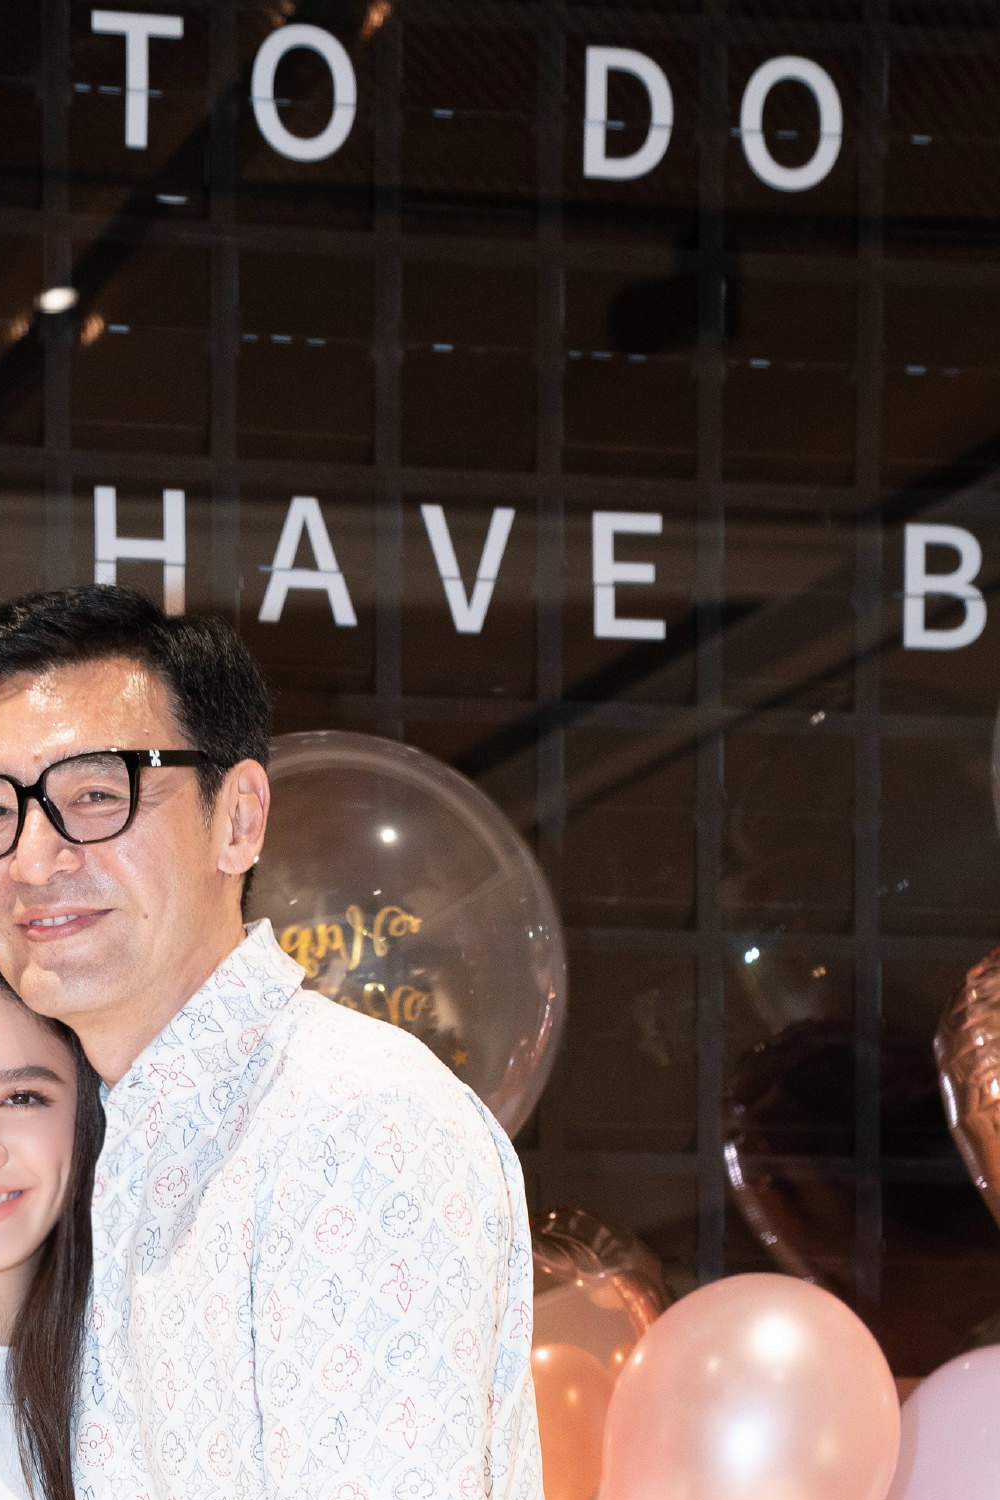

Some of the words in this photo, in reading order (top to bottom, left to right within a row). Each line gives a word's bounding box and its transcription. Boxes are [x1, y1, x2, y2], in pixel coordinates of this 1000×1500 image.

[91, 10, 357, 162] TO
[583, 46, 843, 191] DO
[93, 485, 667, 641] HAVE
